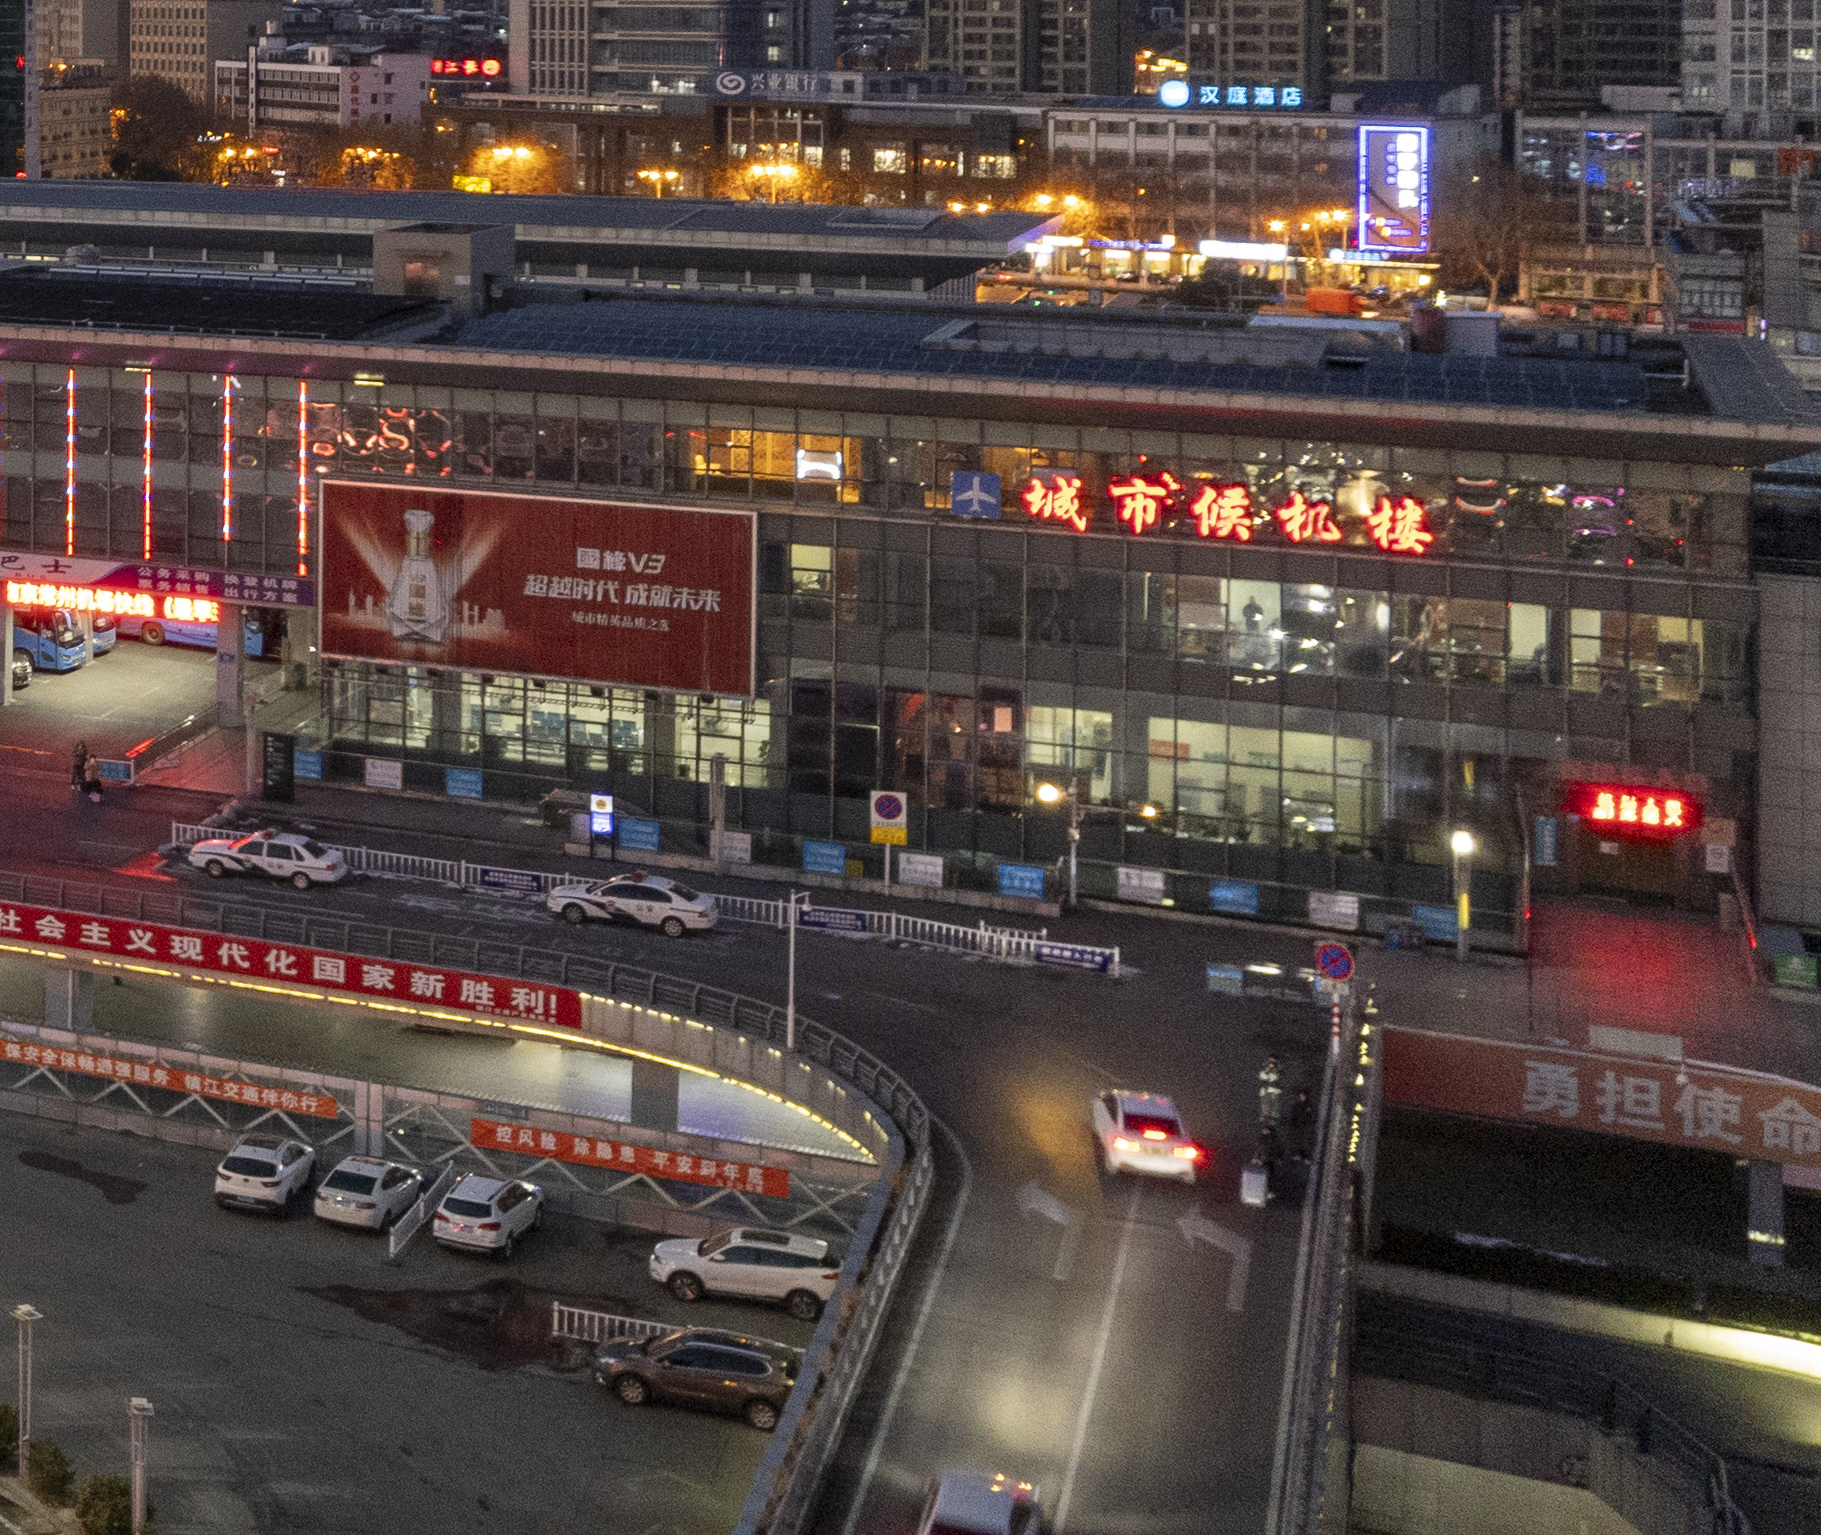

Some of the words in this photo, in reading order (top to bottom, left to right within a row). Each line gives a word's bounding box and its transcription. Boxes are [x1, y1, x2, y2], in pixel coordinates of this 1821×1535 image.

[751, 72, 817, 92] 兴业银行
[1200, 86, 1302, 106] 汉庭酒店
[1023, 473, 1433, 555] 城市候机楼
[137, 566, 210, 582] 公务采购
[224, 574, 298, 590] 换登机牌
[224, 587, 298, 603] 出行方案
[523, 573, 620, 604] 超越时代
[624, 583, 721, 613] 成就未来
[184, 1075, 319, 1113] 镇江交通伴你行
[1523, 1061, 1821, 1156] 勇担使命
[496, 1125, 557, 1150] 控风险
[573, 1136, 636, 1163] 除隐患
[654, 1151, 764, 1186] 平安到年底
